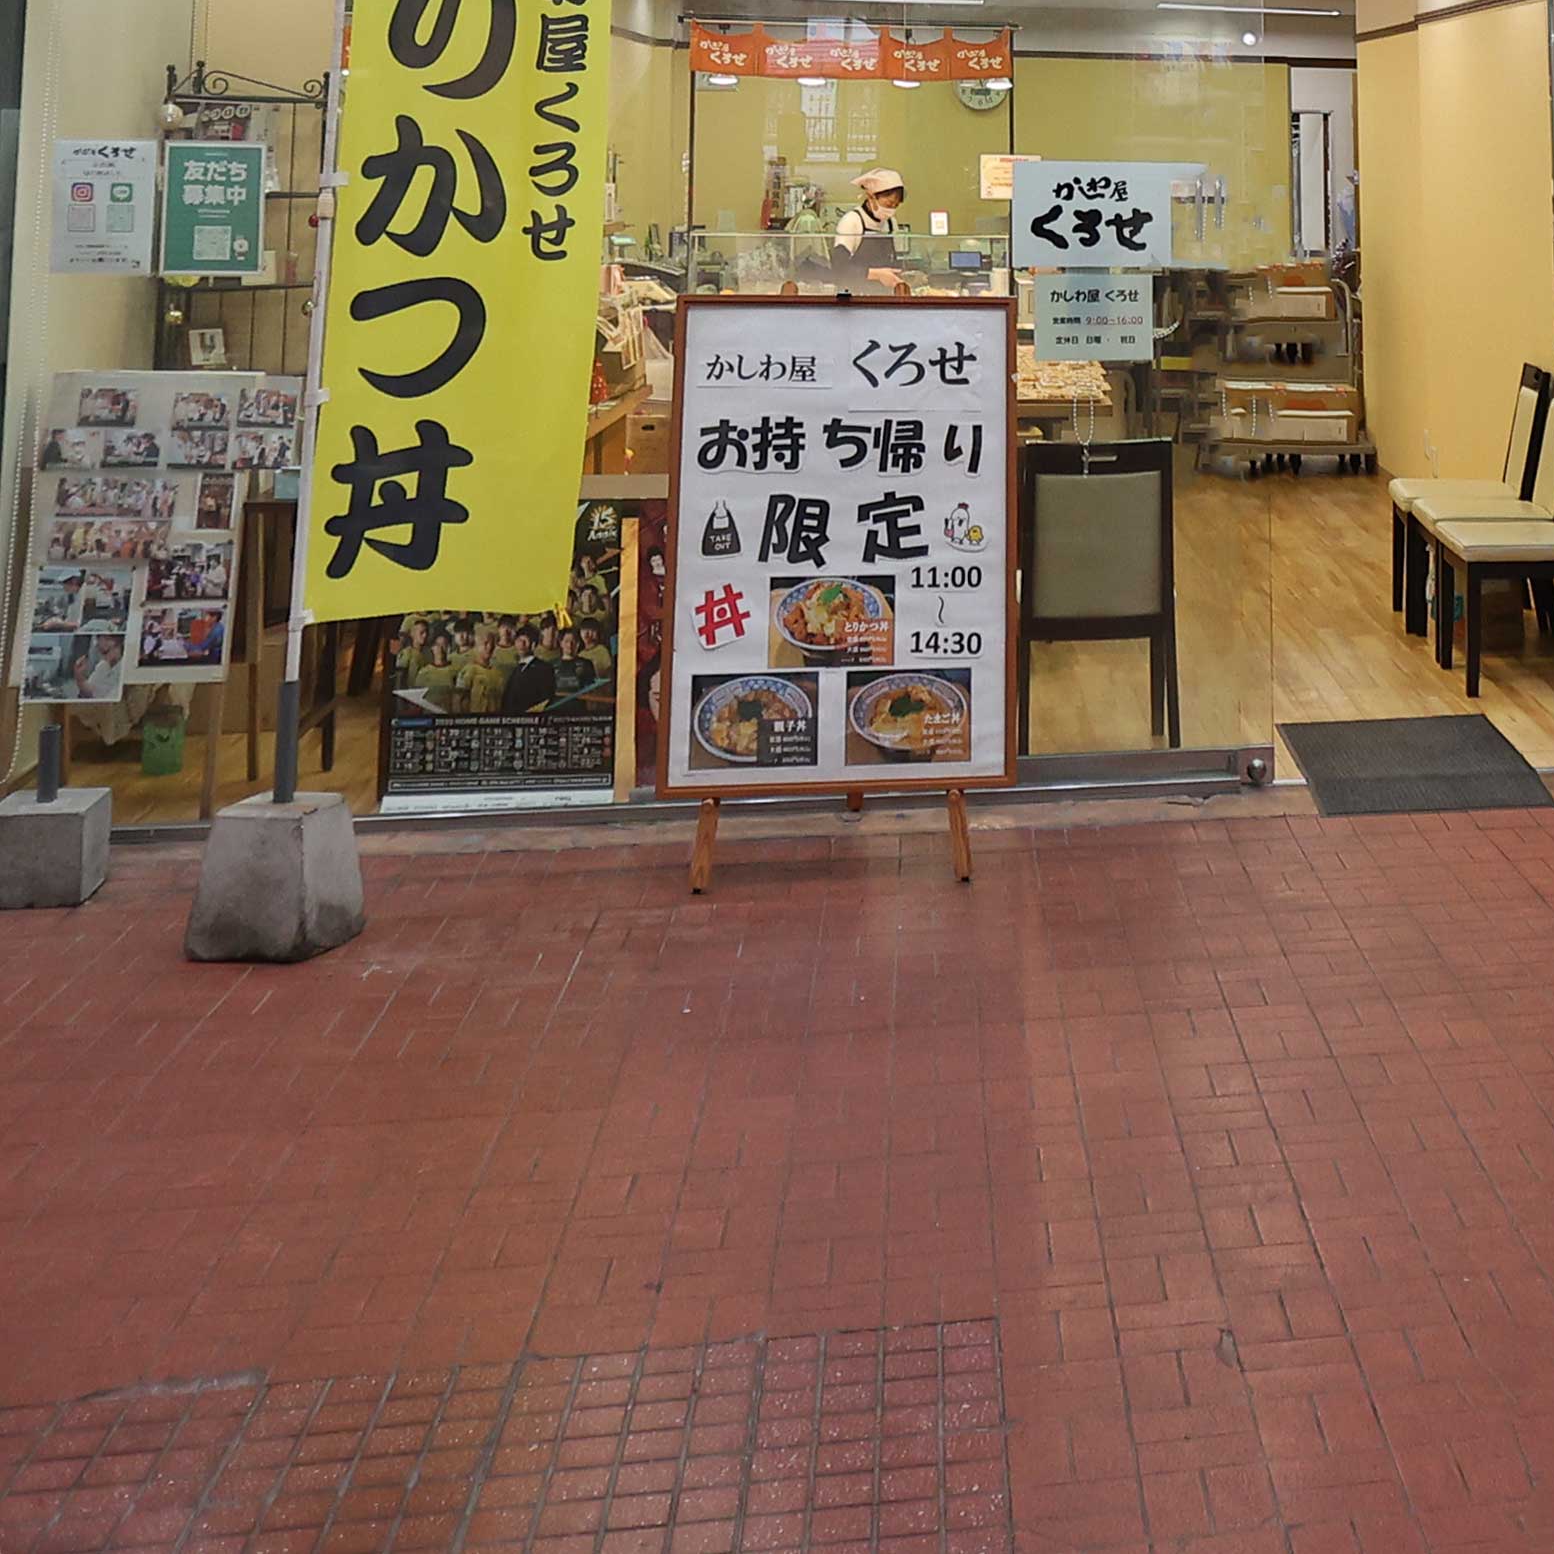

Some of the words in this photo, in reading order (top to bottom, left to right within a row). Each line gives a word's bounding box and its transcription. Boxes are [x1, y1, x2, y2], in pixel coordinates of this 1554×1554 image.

[183, 159, 248, 182] 友だち
[1030, 204, 1153, 251] くろせ
[1050, 290, 1100, 303] かしわ屋
[1104, 289, 1139, 303] くろせ
[705, 354, 817, 383] かしわ屋
[852, 340, 977, 388] くろせ
[697, 416, 983, 474] お持ち帰り
[758, 492, 931, 568] 限定
[910, 566, 982, 588] 11:00
[910, 631, 982, 654] 14:30
